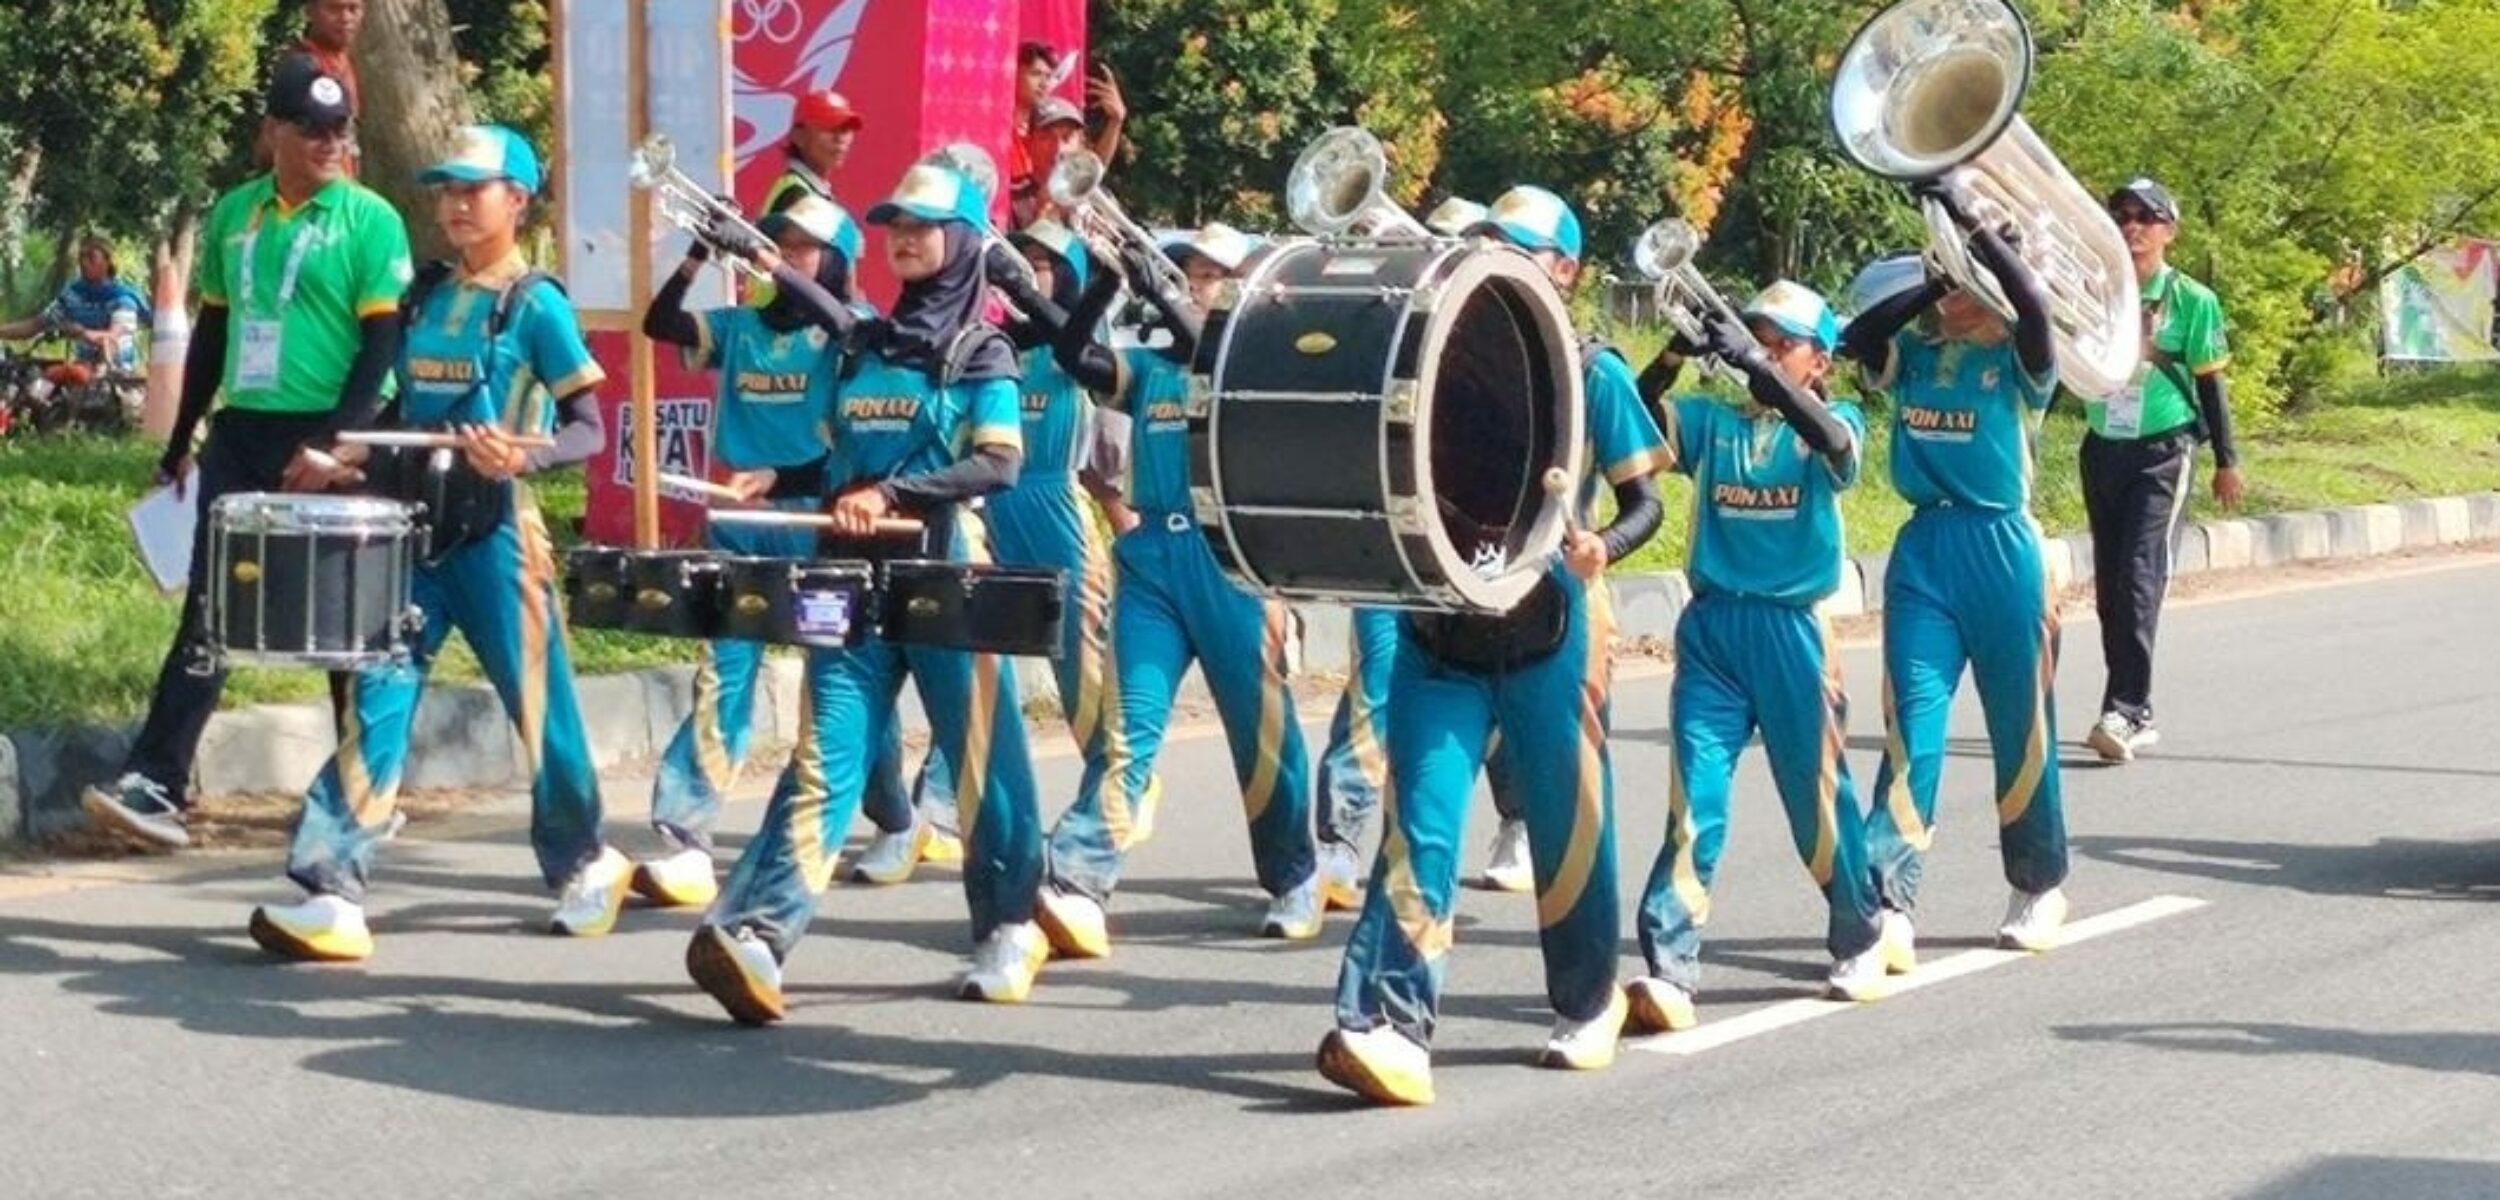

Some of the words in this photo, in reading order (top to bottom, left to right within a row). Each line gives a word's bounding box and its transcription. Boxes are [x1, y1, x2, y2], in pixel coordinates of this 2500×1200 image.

[621, 402, 707, 426] BSATU
[843, 397, 884, 417] PON
[884, 399, 920, 417] XXI
[1902, 406, 1939, 428] PON
[1941, 411, 1974, 429] XXI
[620, 427, 687, 467] KTA
[1716, 483, 1757, 506] PON
[1759, 486, 1799, 507] XXI
